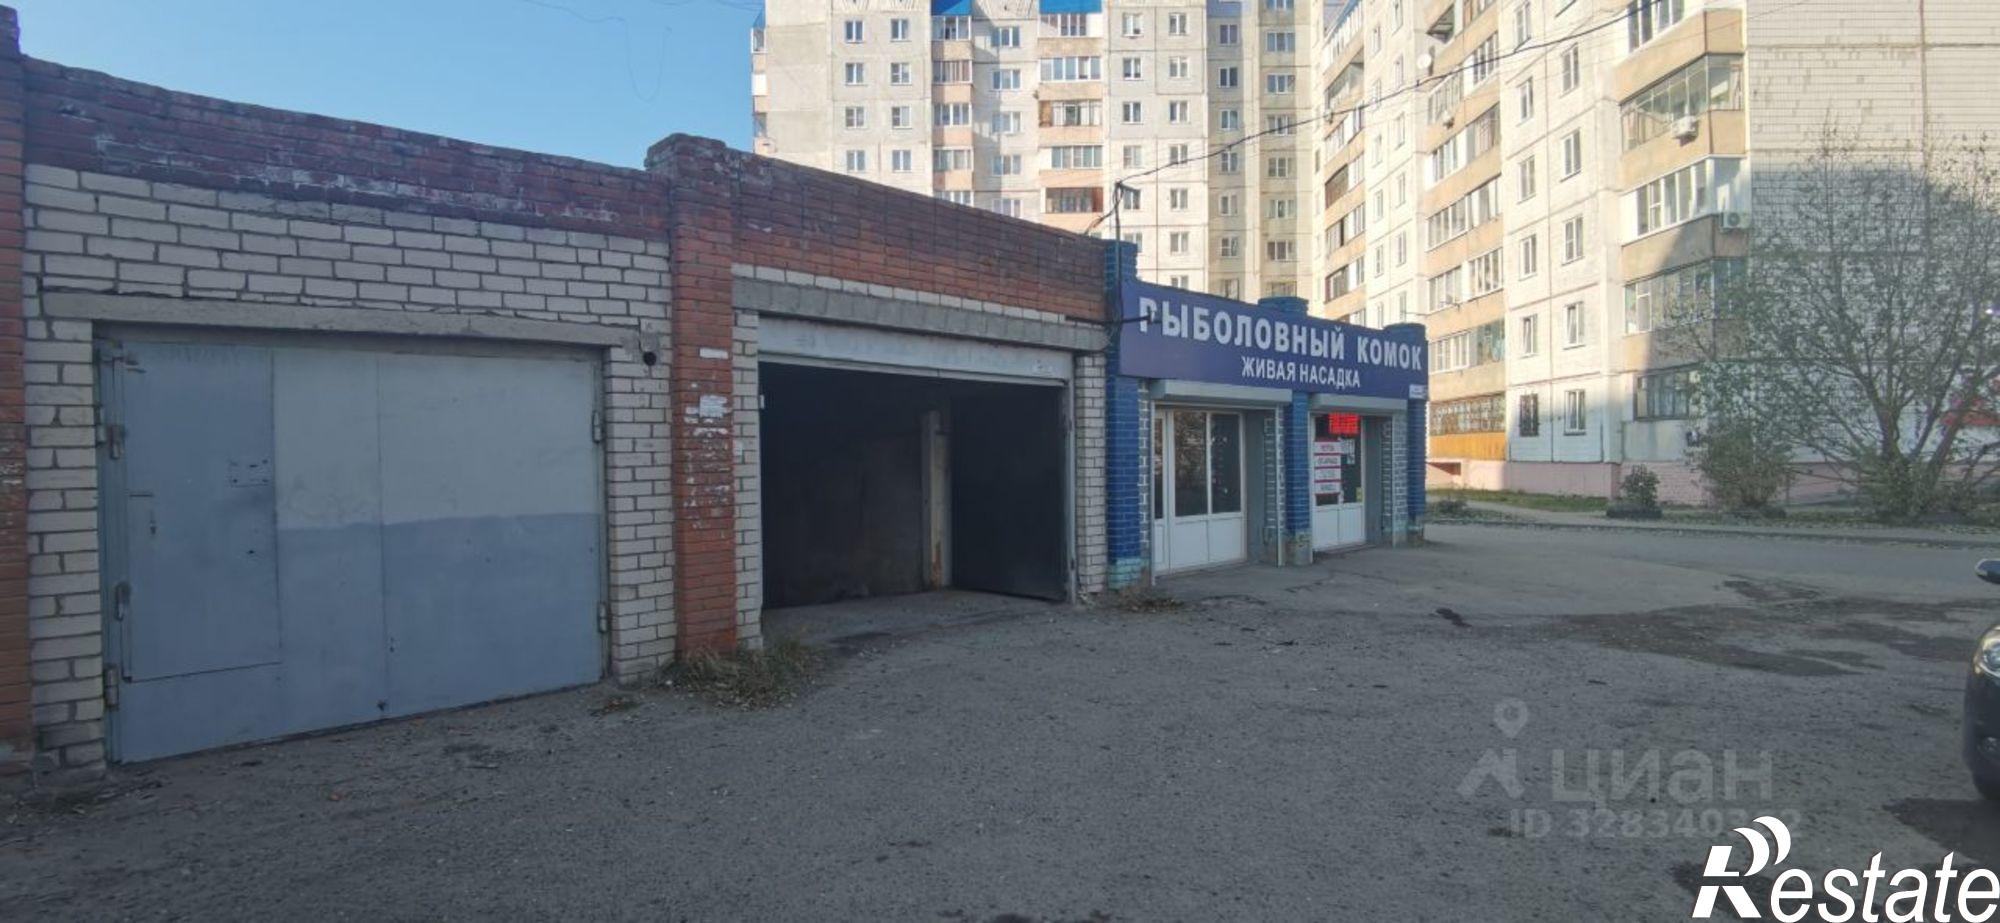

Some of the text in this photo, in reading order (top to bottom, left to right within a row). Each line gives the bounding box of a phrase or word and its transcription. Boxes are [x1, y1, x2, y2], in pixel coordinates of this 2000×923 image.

[1139, 297, 1422, 371] РЫБОЛОВНЫЙ КОМОК
[1241, 356, 1361, 390] ЖИВАЯ НАСАДКА
